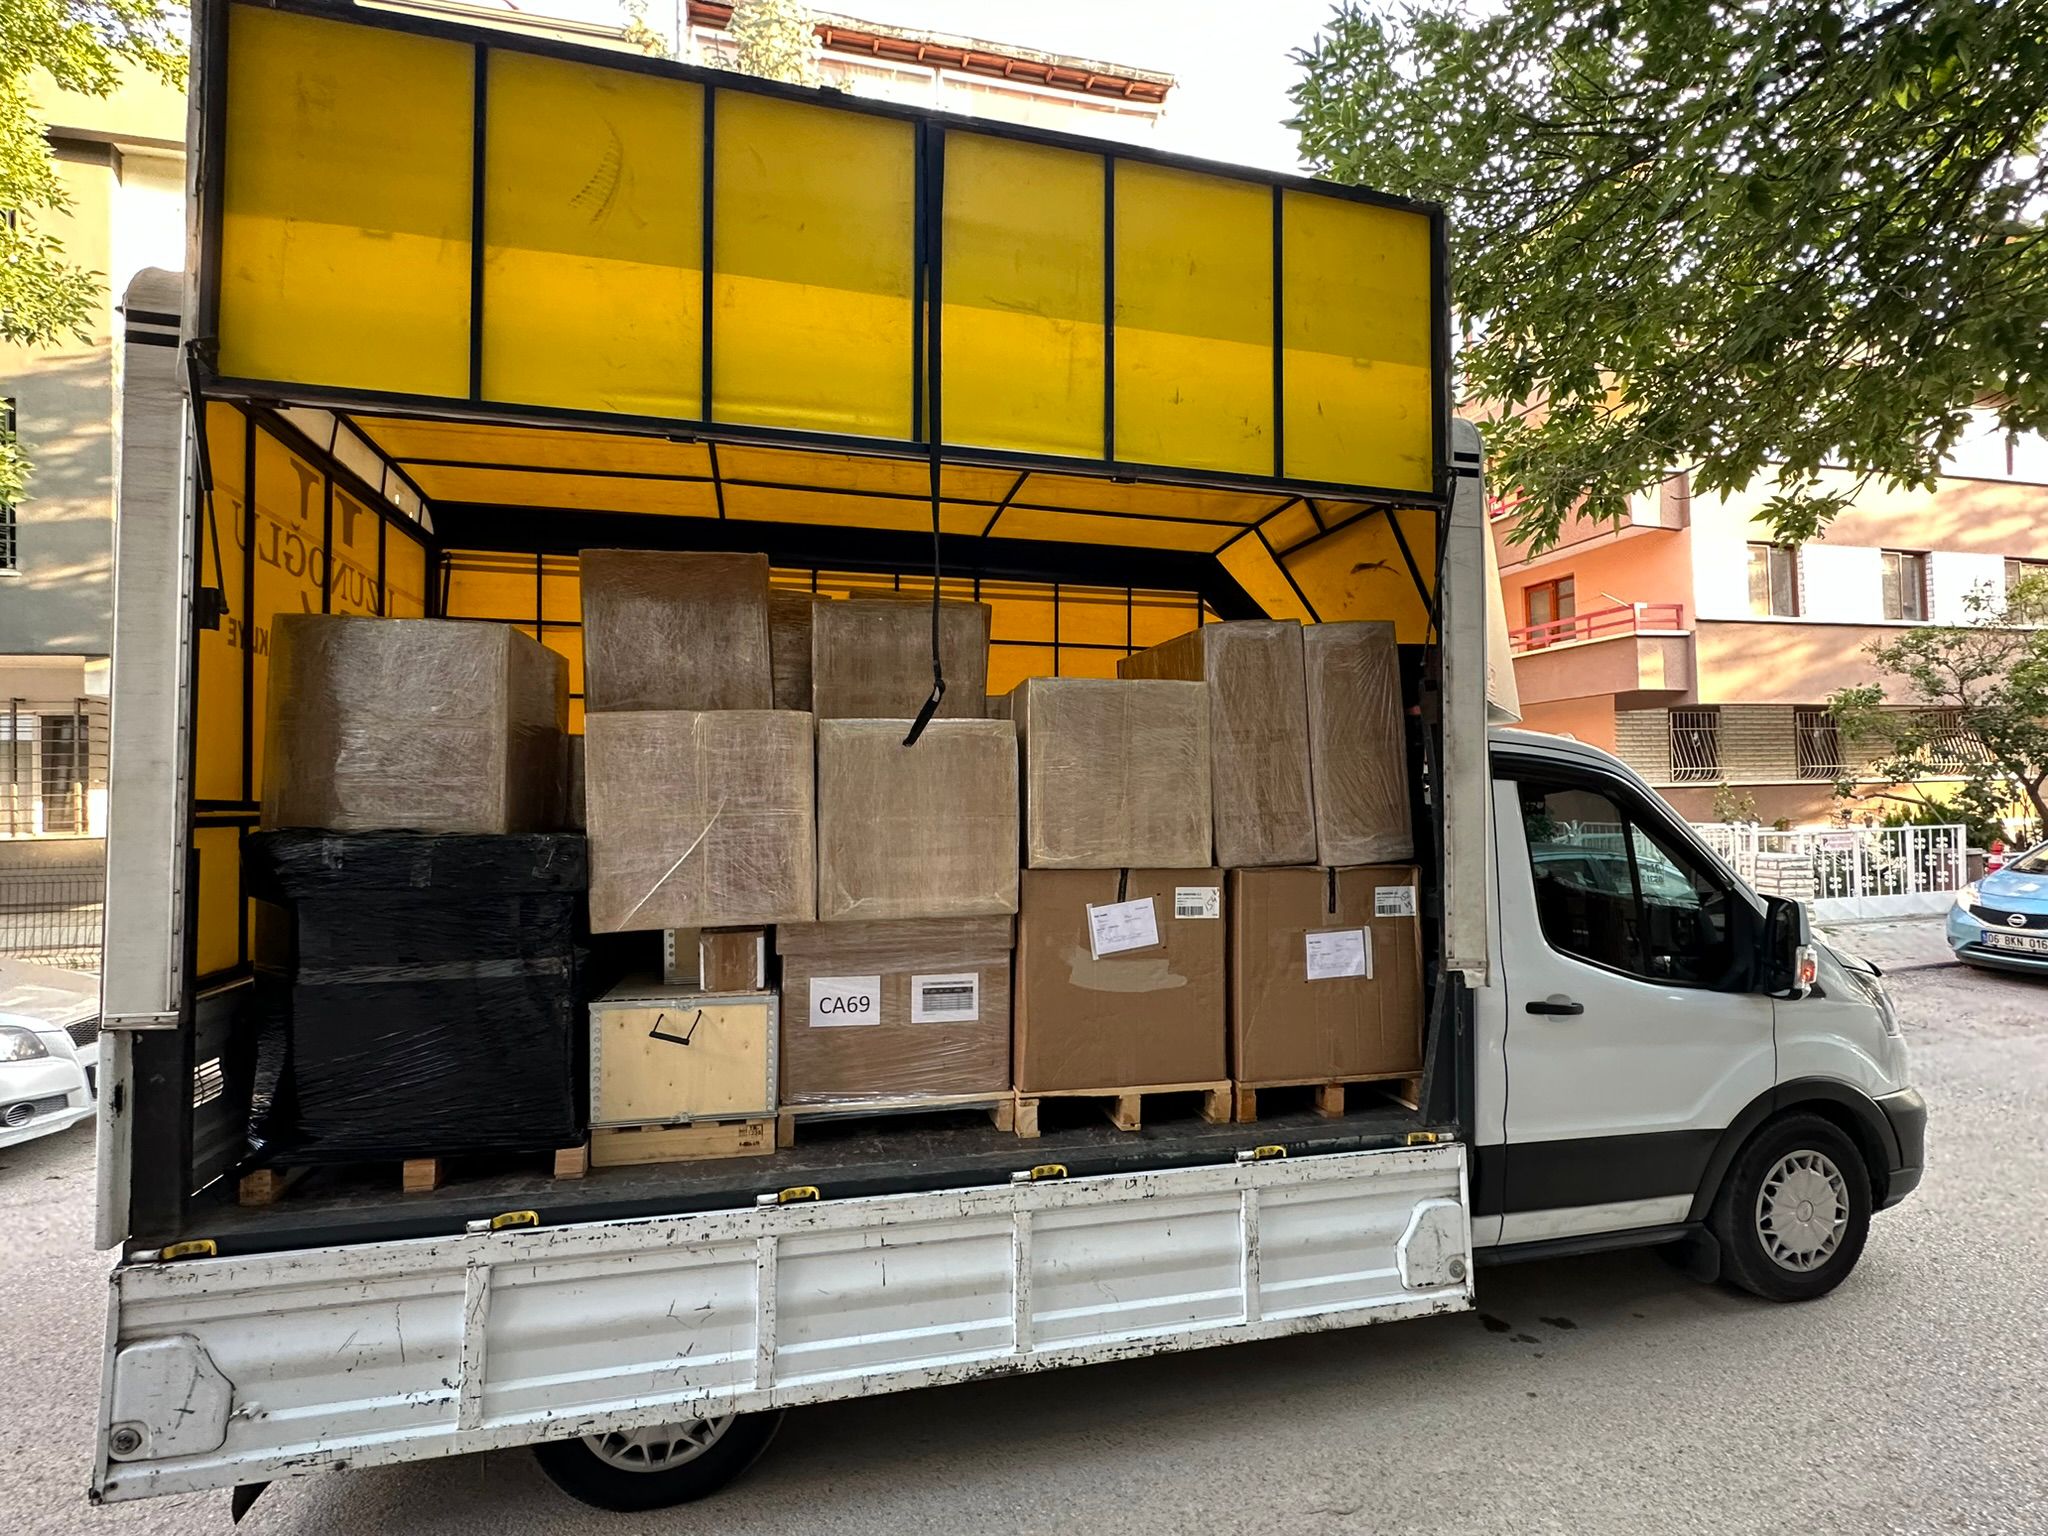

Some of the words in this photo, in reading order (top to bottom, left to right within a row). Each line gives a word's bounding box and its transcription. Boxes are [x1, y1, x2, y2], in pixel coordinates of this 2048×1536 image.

[1988, 934, 1999, 944] 06
[2004, 936, 2023, 946] BKN
[2029, 939, 2048, 950] 016
[819, 996, 870, 1014] CA69
